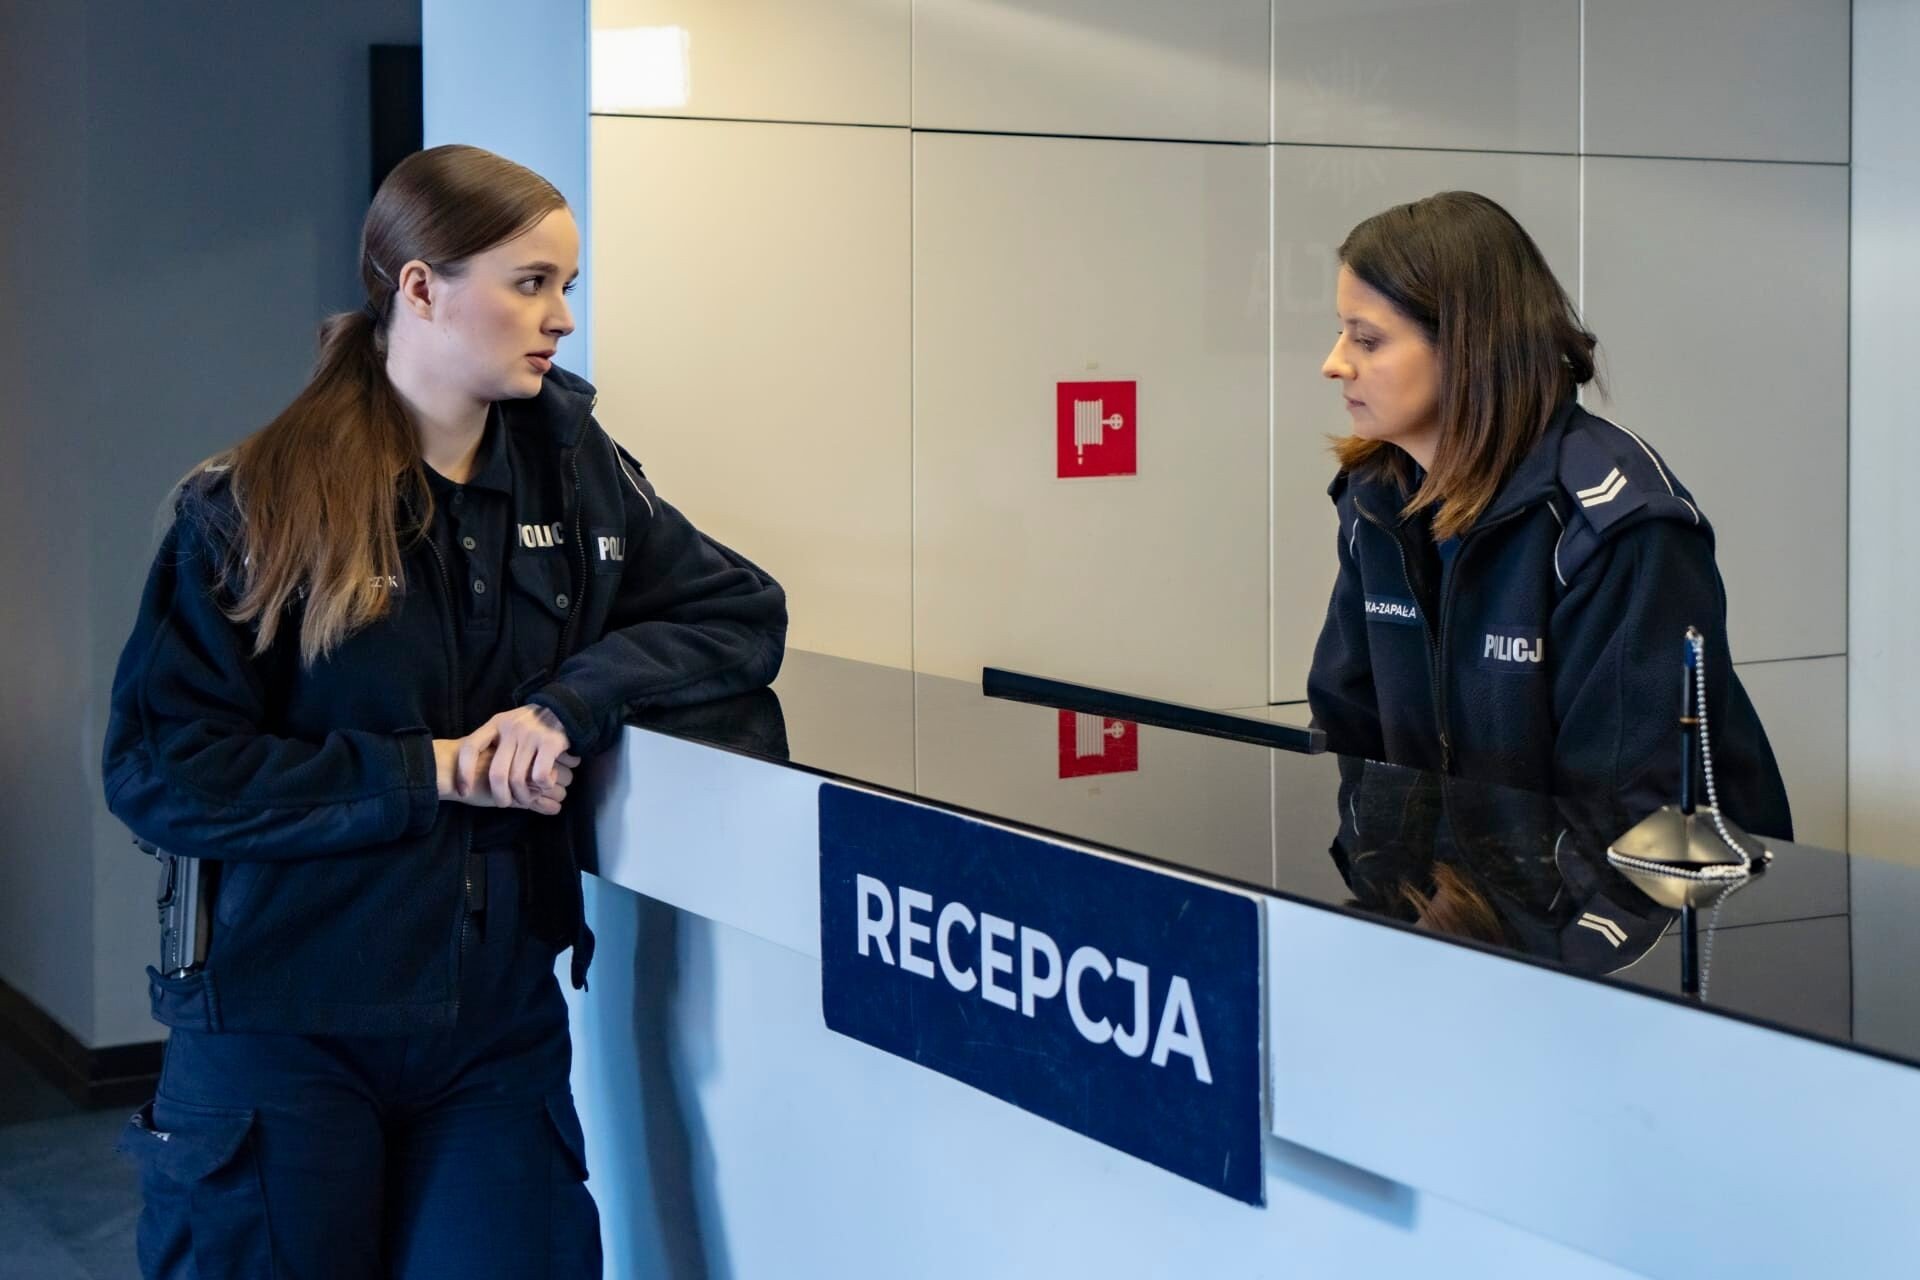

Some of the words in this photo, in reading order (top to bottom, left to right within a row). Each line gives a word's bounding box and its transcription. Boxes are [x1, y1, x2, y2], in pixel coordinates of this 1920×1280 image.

[518, 522, 564, 548] OLIC
[598, 536, 626, 560] POL
[856, 873, 1213, 1085] RECEPCJA
